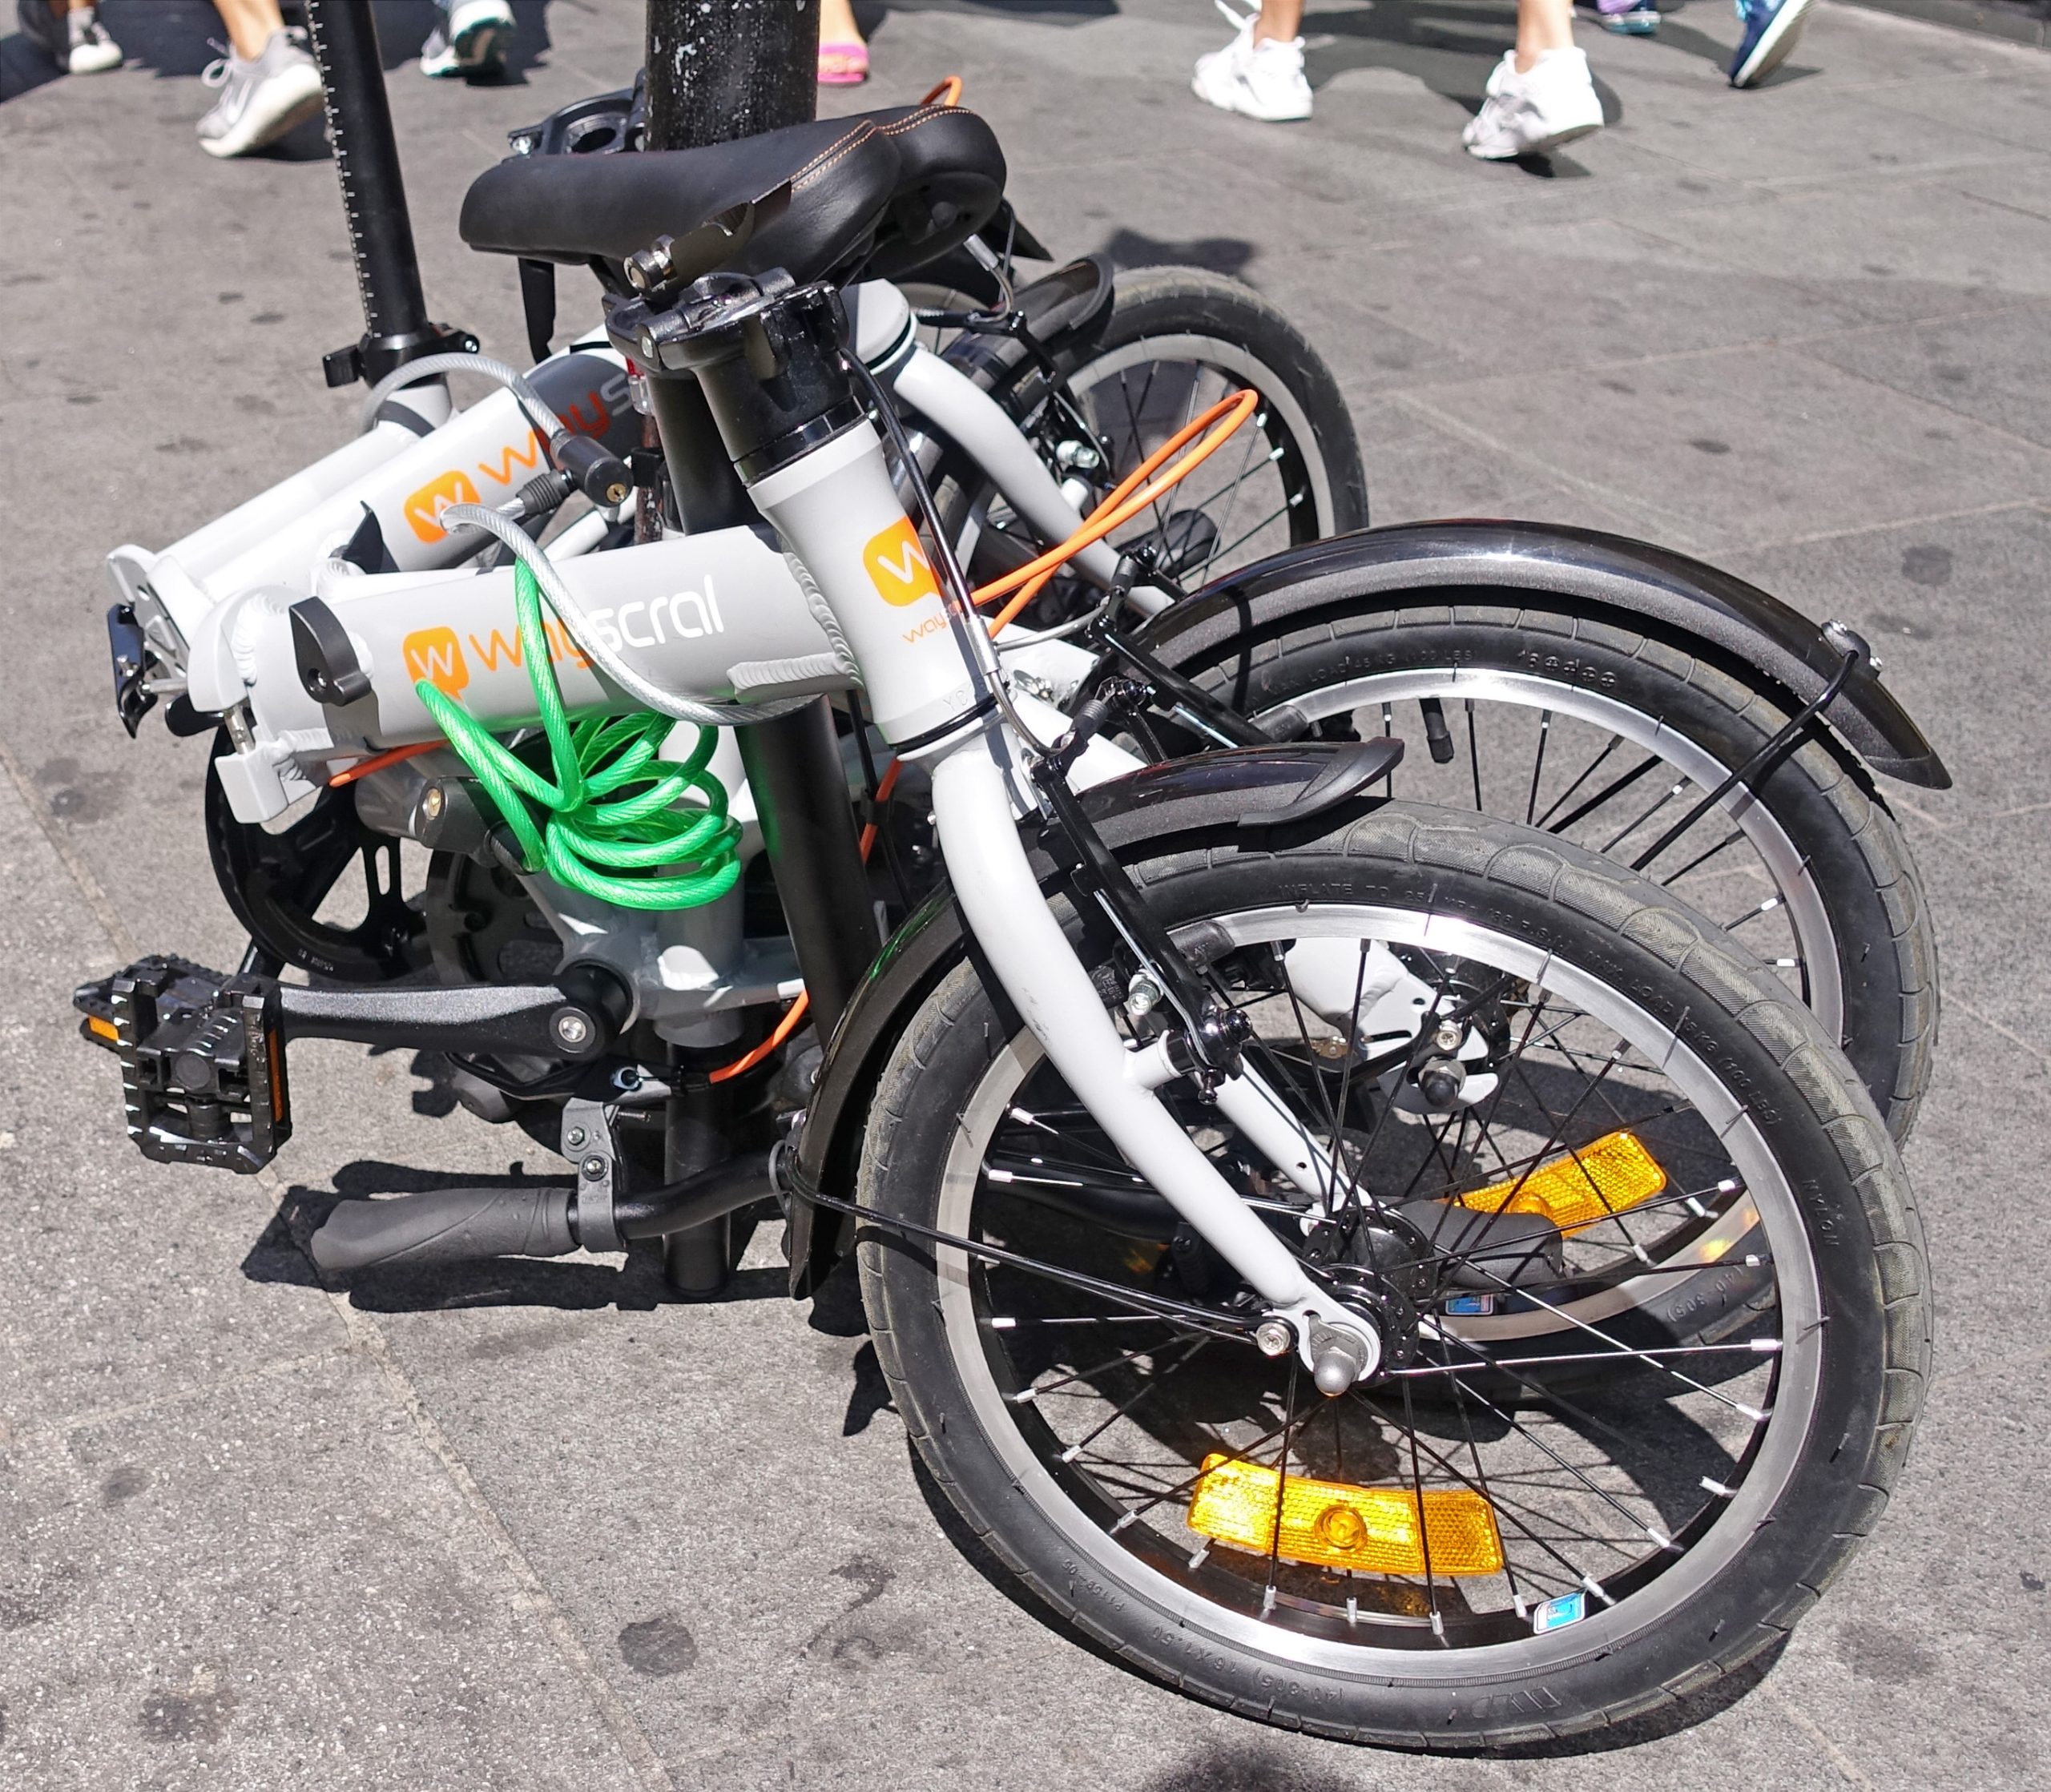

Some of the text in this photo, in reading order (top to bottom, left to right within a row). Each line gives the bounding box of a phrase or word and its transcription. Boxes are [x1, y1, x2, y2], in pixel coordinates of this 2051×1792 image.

[1365, 884, 1390, 898] TO
[1630, 978, 1674, 1013] LOAD
[1801, 1178, 1840, 1247] NYLON
